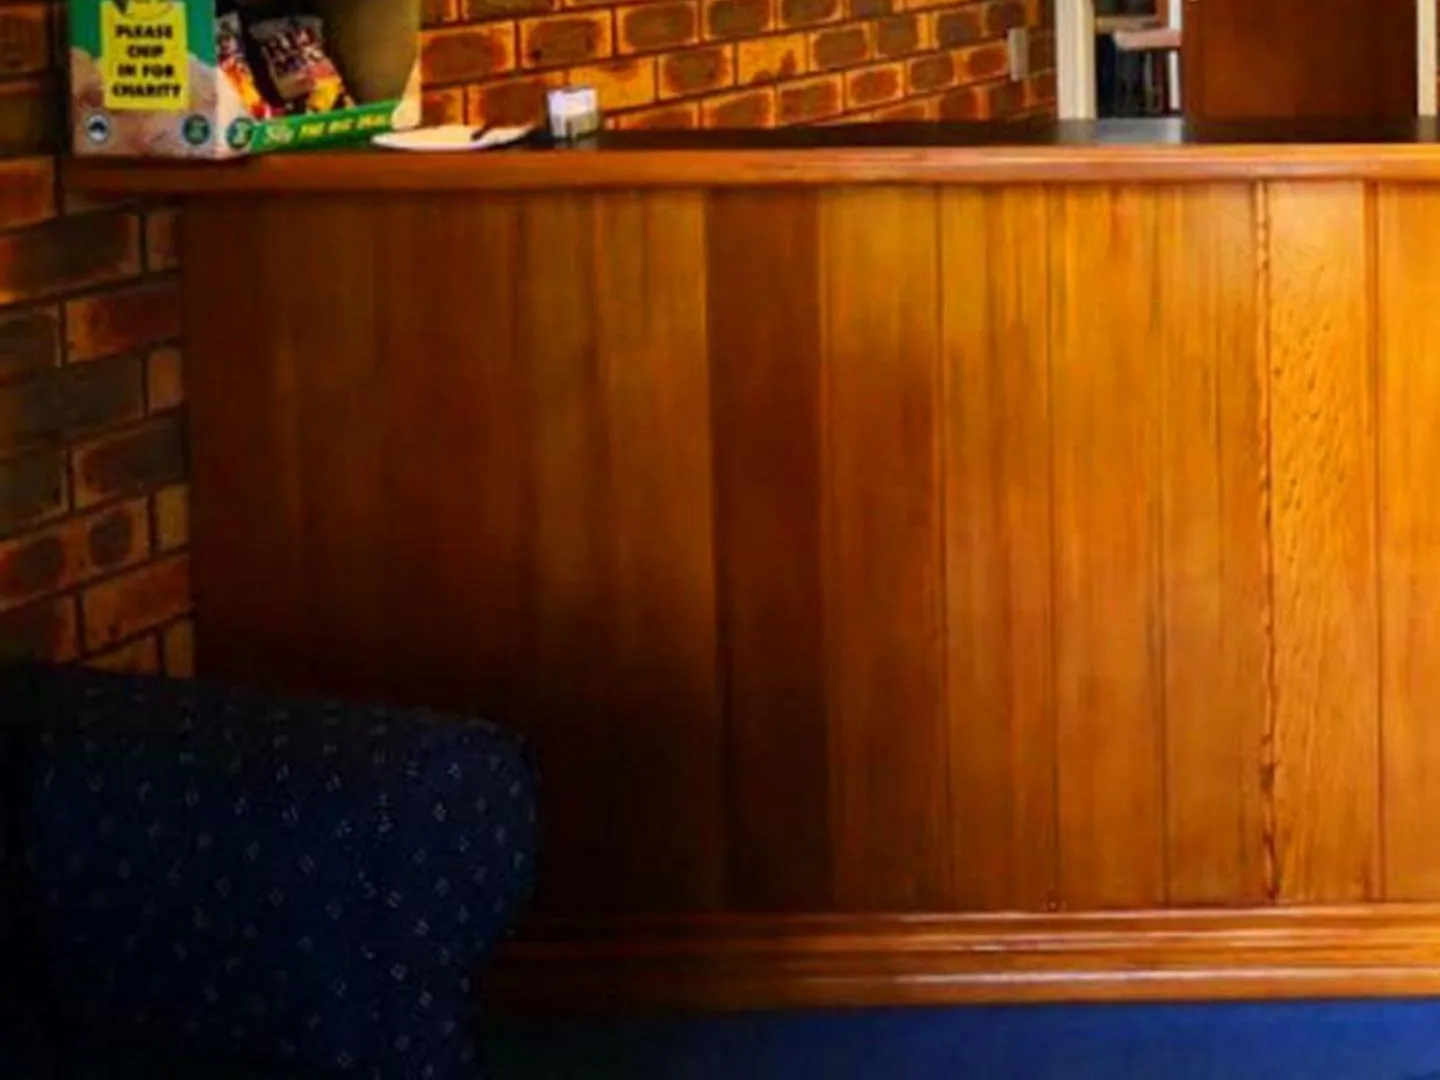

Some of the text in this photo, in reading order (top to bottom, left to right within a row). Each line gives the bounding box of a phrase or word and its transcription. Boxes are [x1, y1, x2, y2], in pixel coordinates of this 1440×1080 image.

[115, 25, 173, 39] PLEASE
[117, 64, 174, 78] IN FOR
[112, 82, 181, 98] CHARITY
